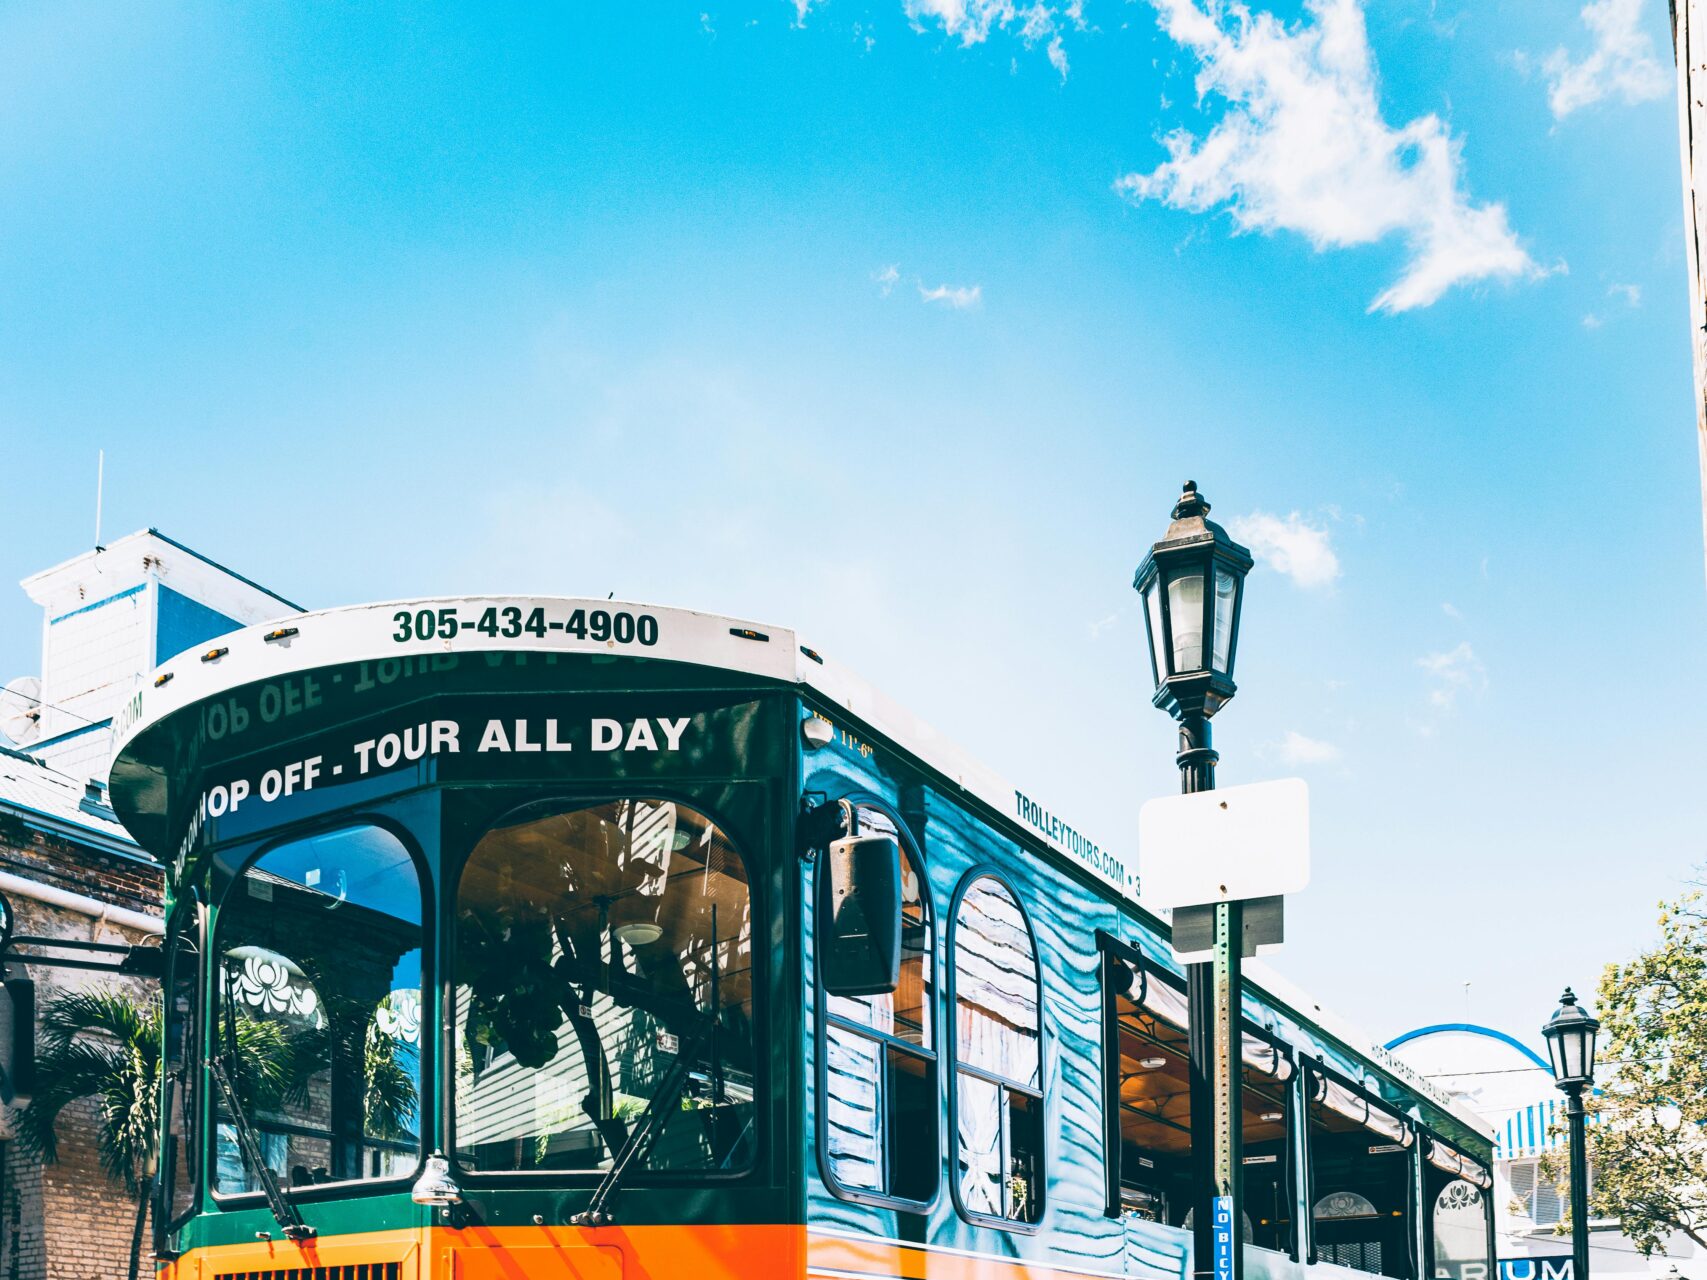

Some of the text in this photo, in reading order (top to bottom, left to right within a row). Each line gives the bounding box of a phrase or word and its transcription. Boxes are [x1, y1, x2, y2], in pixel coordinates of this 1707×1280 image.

[393, 606, 660, 647] 305-434-4900
[199, 779, 250, 829] HOP
[260, 756, 323, 803] OFF
[353, 720, 461, 775] TOUR
[476, 718, 573, 752] ALL
[590, 717, 691, 752] DAY
[1015, 789, 1125, 886] TROLLEYTOURS.COM
[1218, 1200, 1229, 1223] NO
